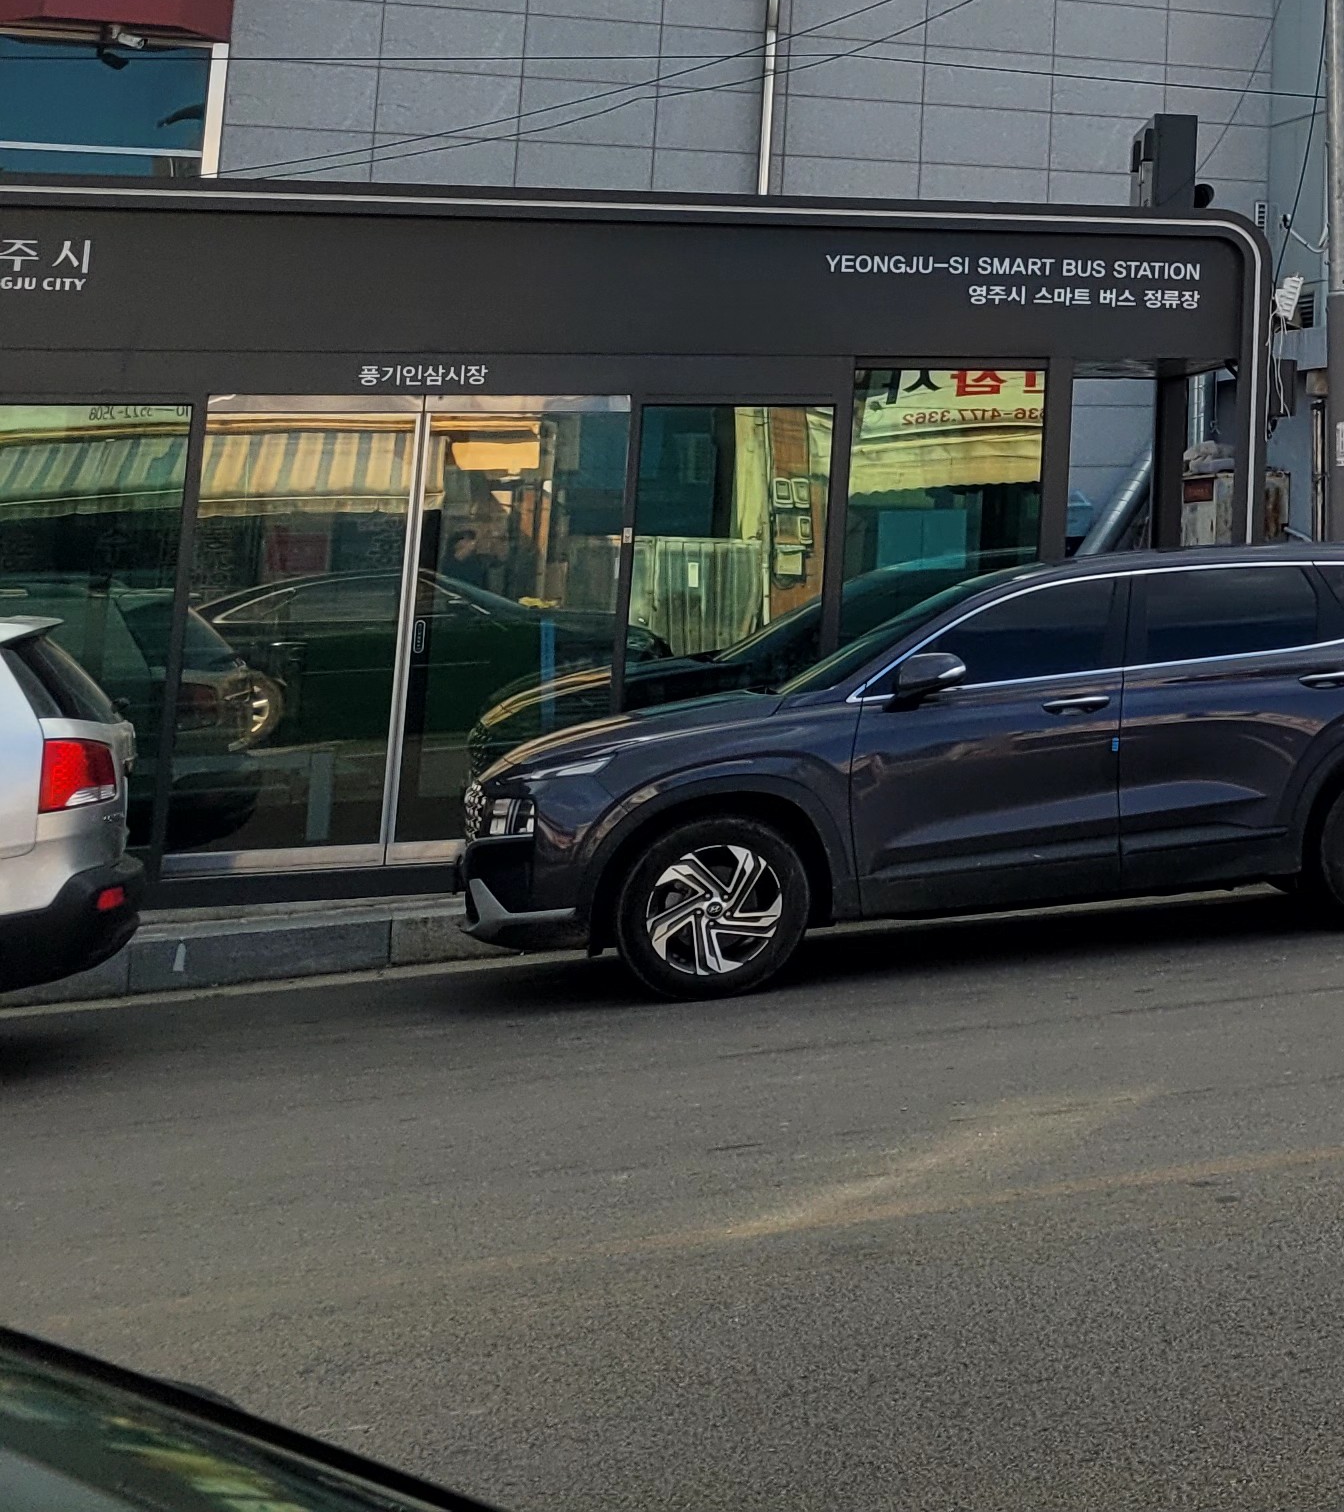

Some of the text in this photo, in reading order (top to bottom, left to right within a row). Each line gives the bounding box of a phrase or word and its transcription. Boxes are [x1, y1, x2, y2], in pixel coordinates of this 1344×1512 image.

[825, 255, 1201, 282] YEONGJU-SI SMART BUS STATION
[42, 277, 87, 291] CITY
[968, 285, 1201, 309] 영주시 스마트 버스 정류장
[357, 364, 489, 387] 풍기인삼시장
